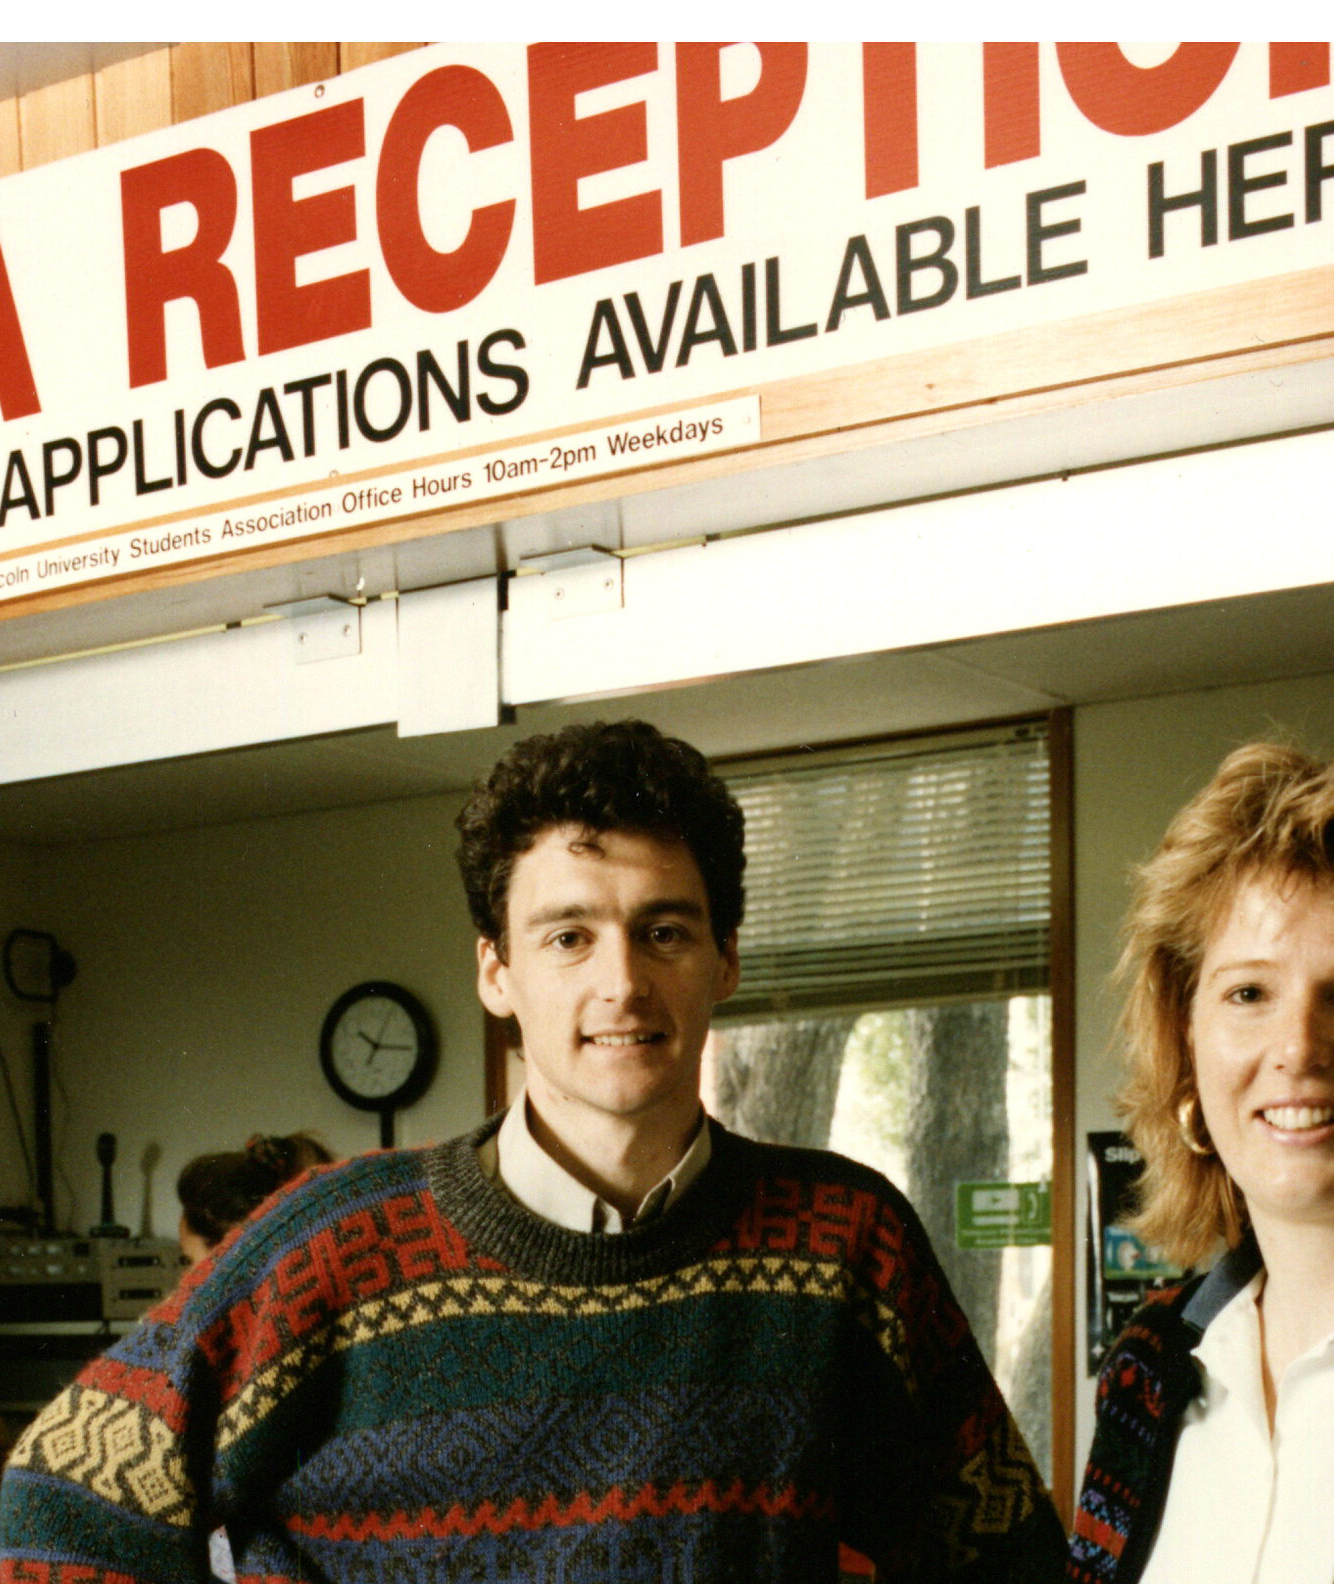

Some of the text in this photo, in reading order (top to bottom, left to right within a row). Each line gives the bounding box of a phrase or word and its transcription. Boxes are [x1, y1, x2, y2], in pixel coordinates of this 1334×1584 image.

[574, 179, 1088, 389] AVAILABLE
[36, 543, 121, 586] University
[129, 525, 212, 560] Students
[220, 498, 332, 542] Association
[341, 482, 403, 516] Office
[411, 466, 473, 501] Hours
[482, 443, 597, 486] 10am-2pm
[606, 413, 725, 459] Weekdays
